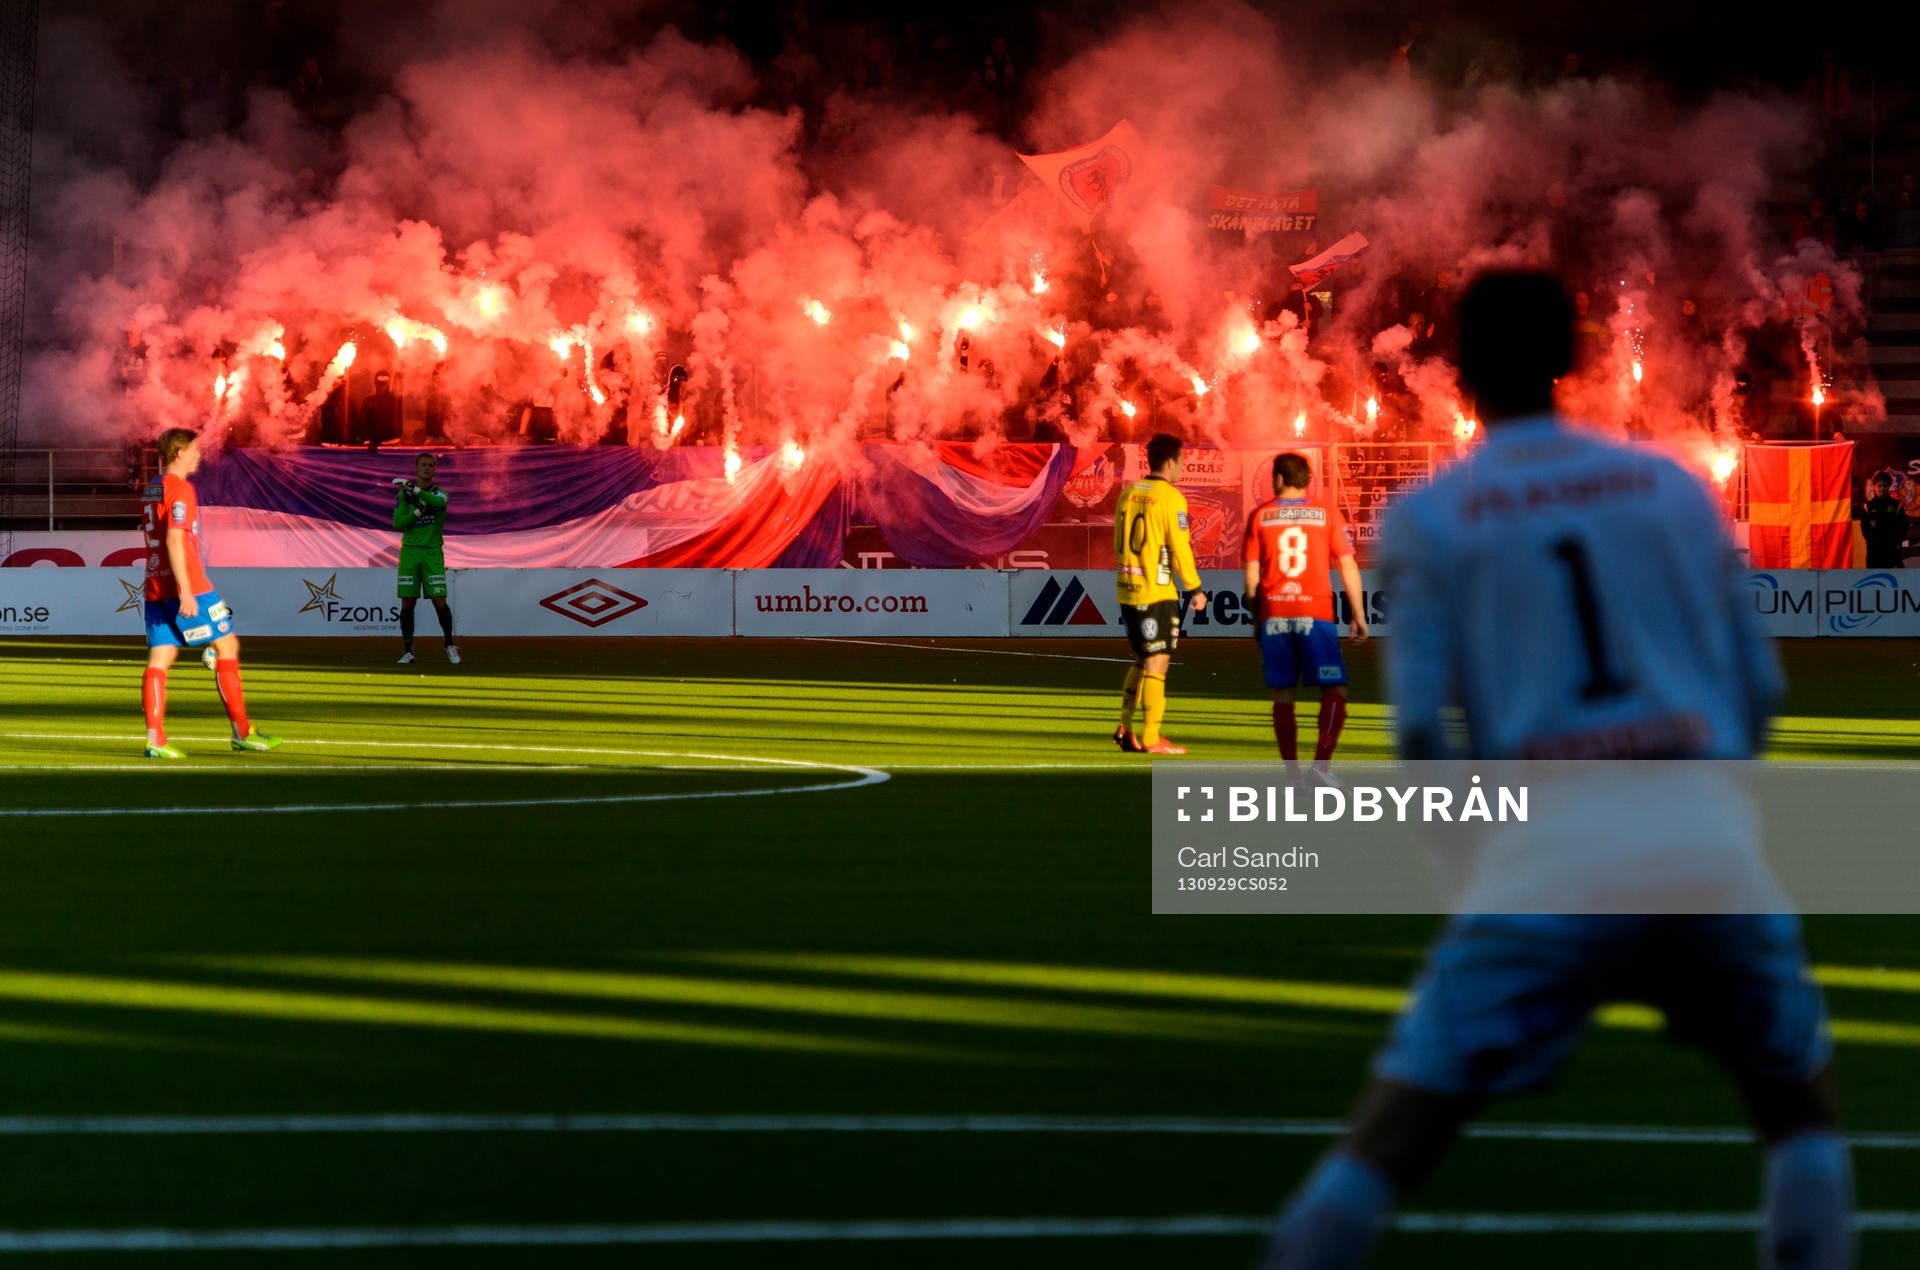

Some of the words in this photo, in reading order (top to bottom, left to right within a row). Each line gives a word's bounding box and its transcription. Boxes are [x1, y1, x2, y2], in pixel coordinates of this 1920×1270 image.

[1119, 511, 1147, 557] 10
[1278, 526, 1308, 577] 8
[0, 607, 49, 622] n.se
[327, 602, 400, 622] Fzon.s
[755, 585, 928, 613] umbro.com
[1551, 532, 1643, 704] 1
